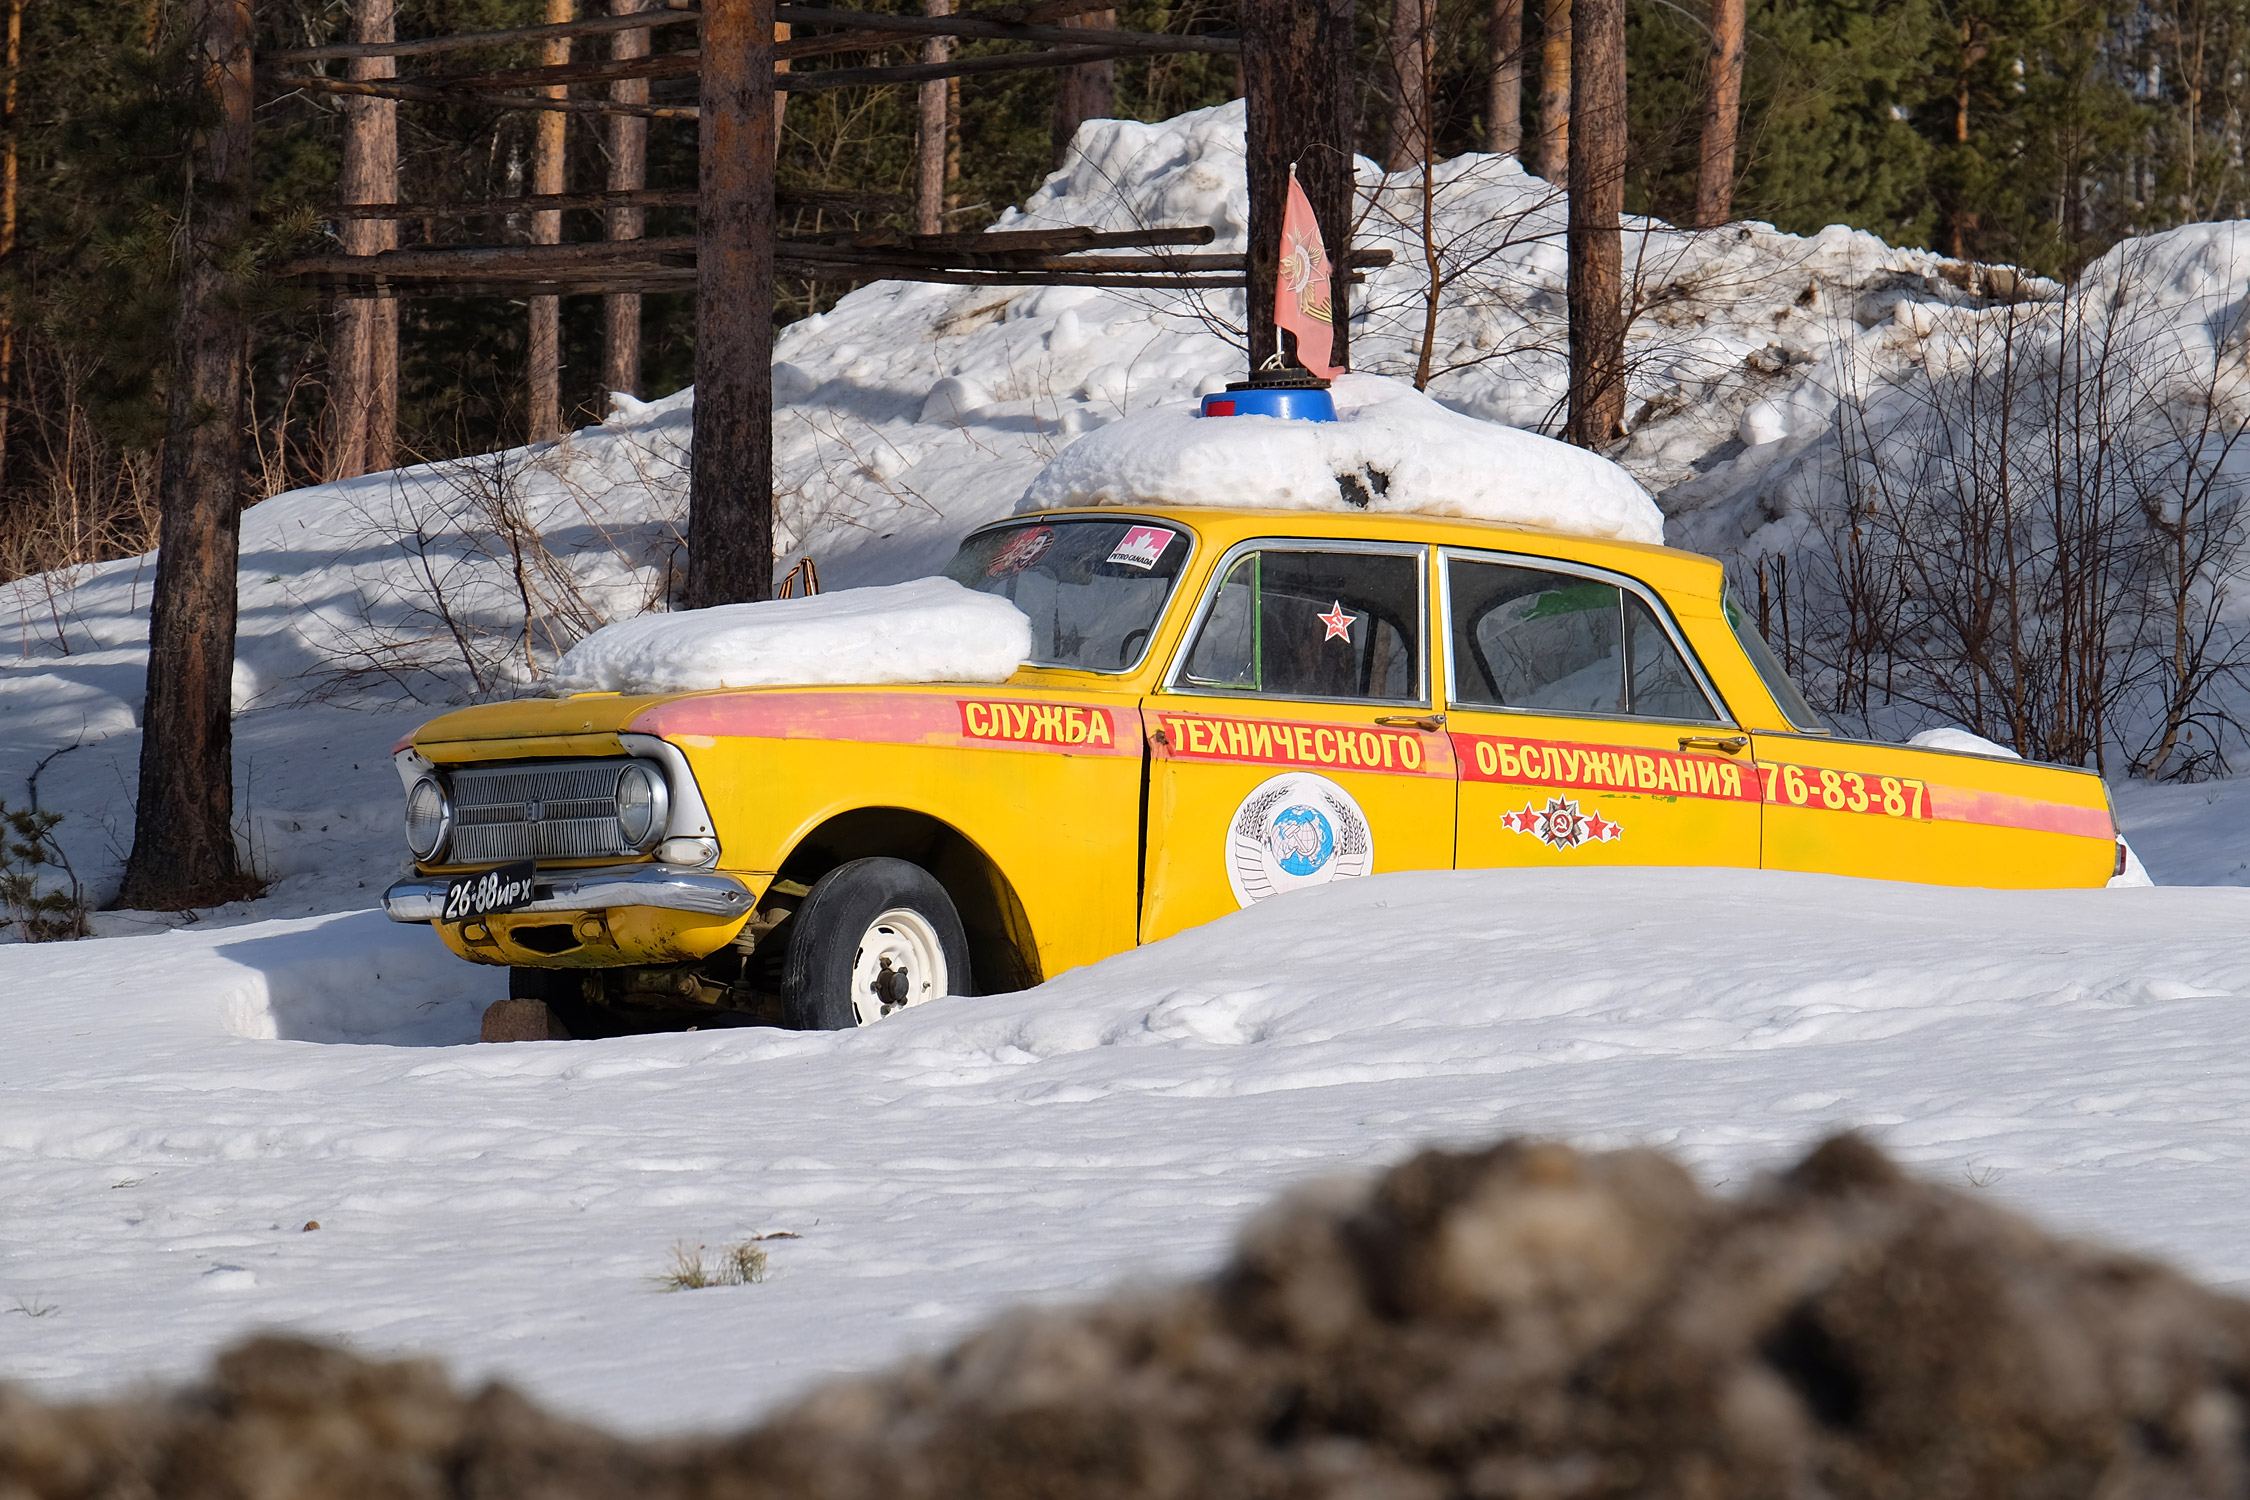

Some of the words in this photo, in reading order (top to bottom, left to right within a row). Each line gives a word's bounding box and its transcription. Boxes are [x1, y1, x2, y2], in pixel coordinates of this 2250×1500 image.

[965, 702, 1111, 745] СЛУЖБА
[1165, 717, 1421, 771] ТЕХНИЧЕСКОГО
[1475, 741, 1742, 798] ОБСЛУЖИВАНИЯ
[1757, 761, 1924, 819] 76-83-87
